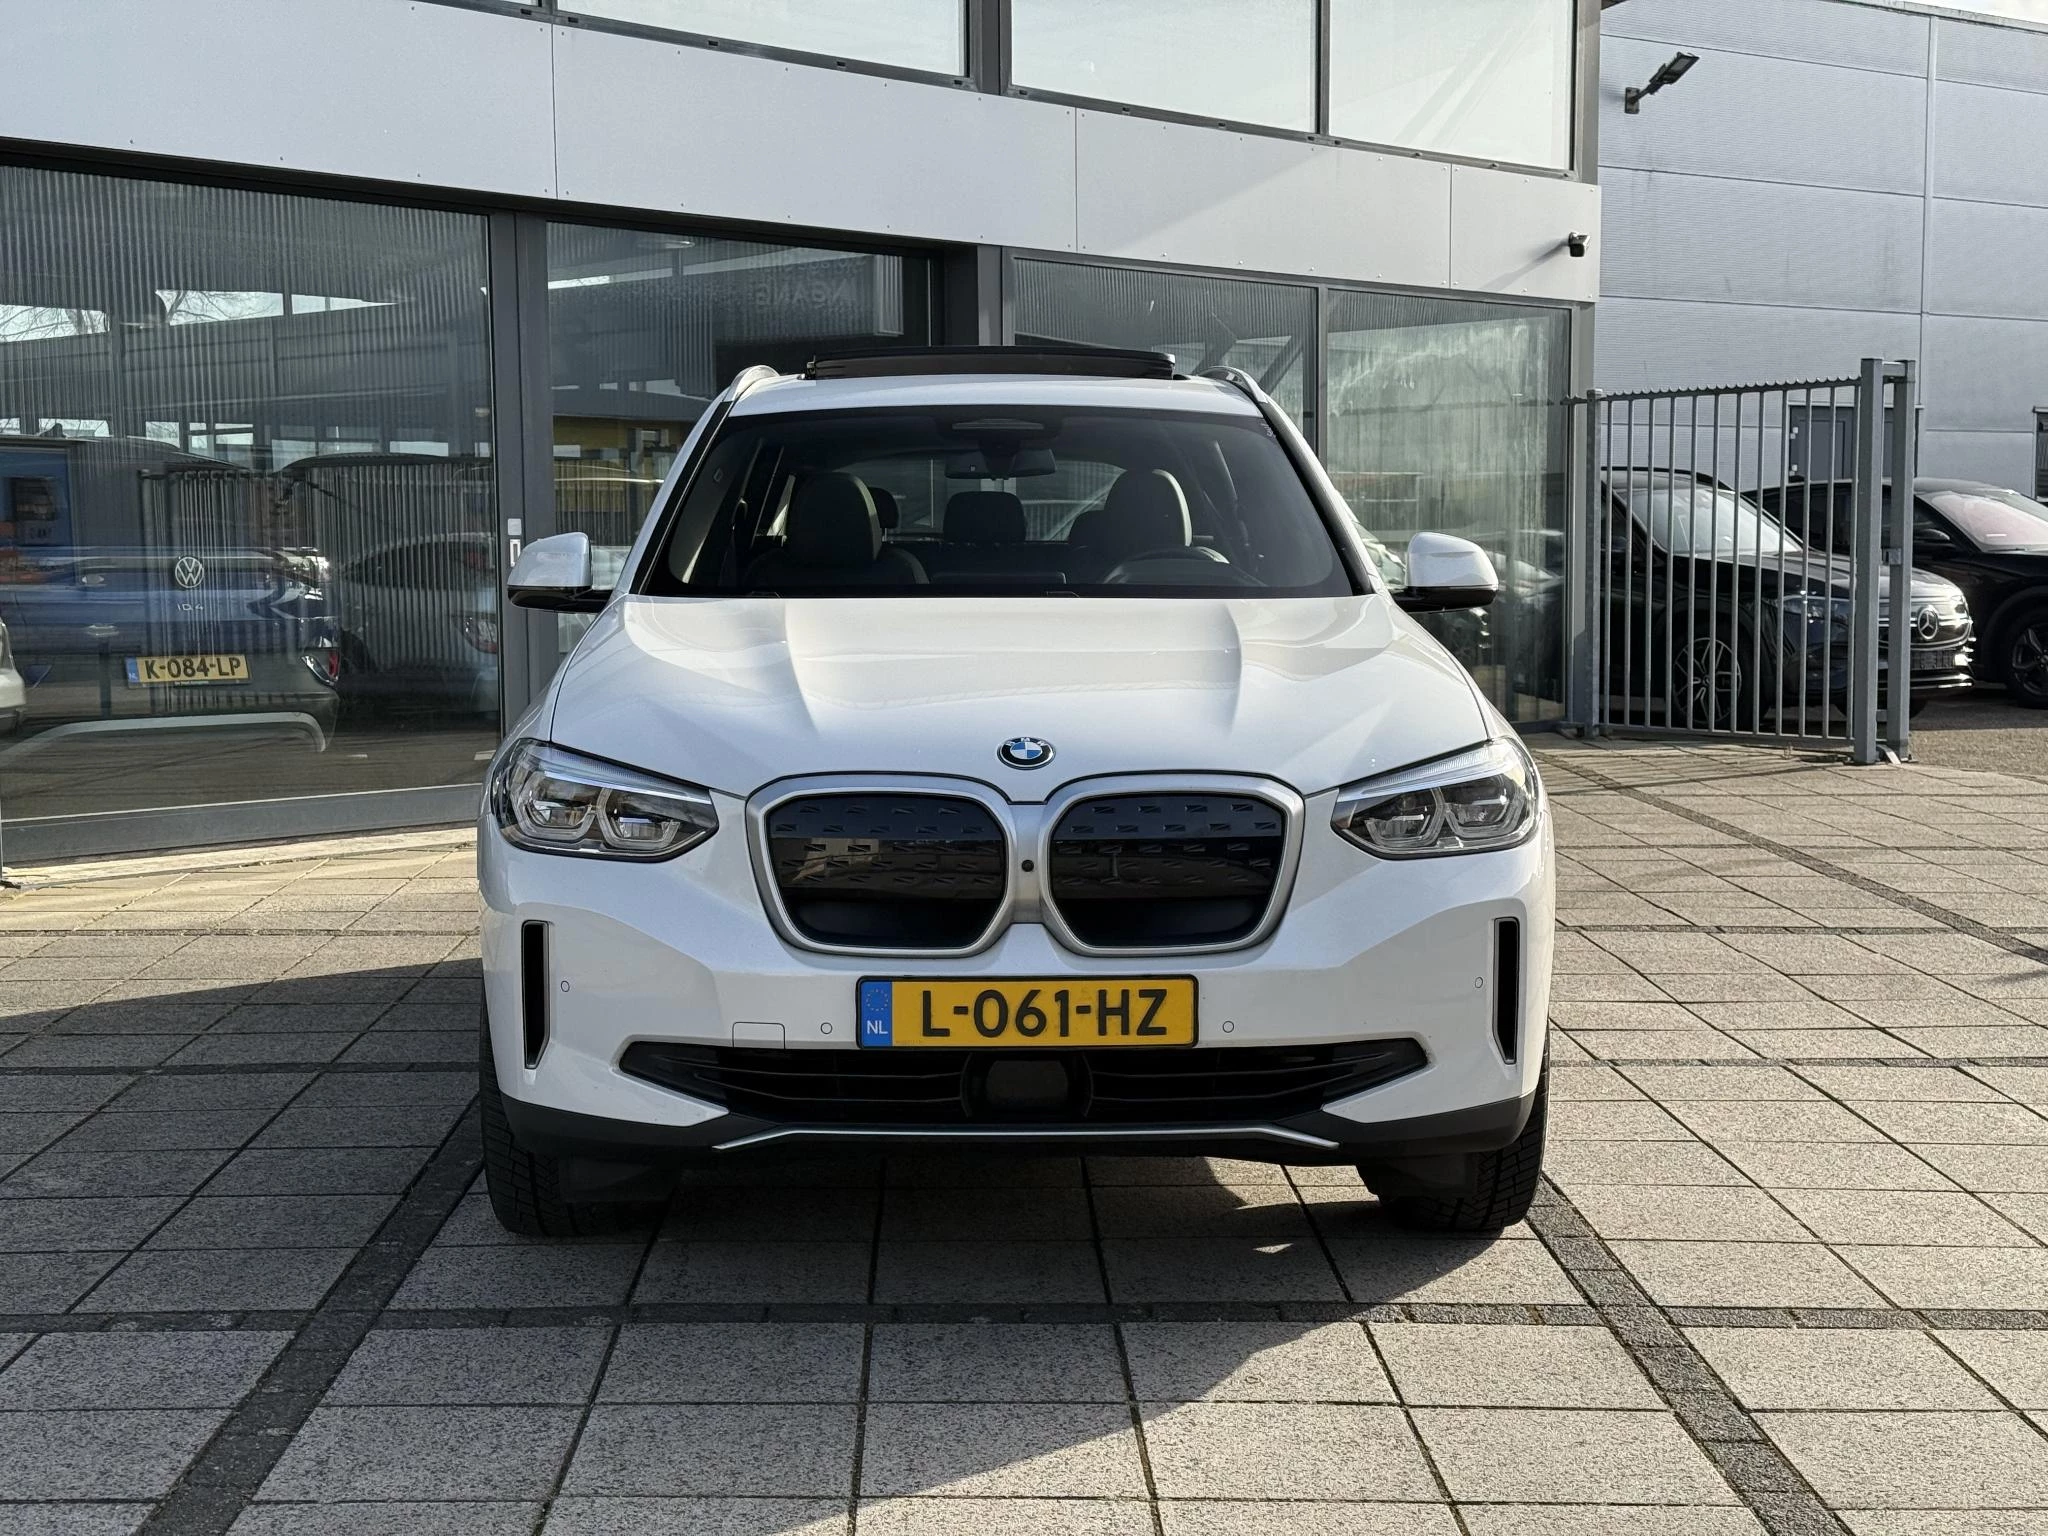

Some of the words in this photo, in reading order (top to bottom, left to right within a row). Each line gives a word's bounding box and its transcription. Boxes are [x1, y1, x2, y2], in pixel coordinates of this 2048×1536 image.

[144, 657, 241, 680] K-084-LP
[922, 989, 1168, 1039] L-061-HZ
[866, 1020, 888, 1035] NL
